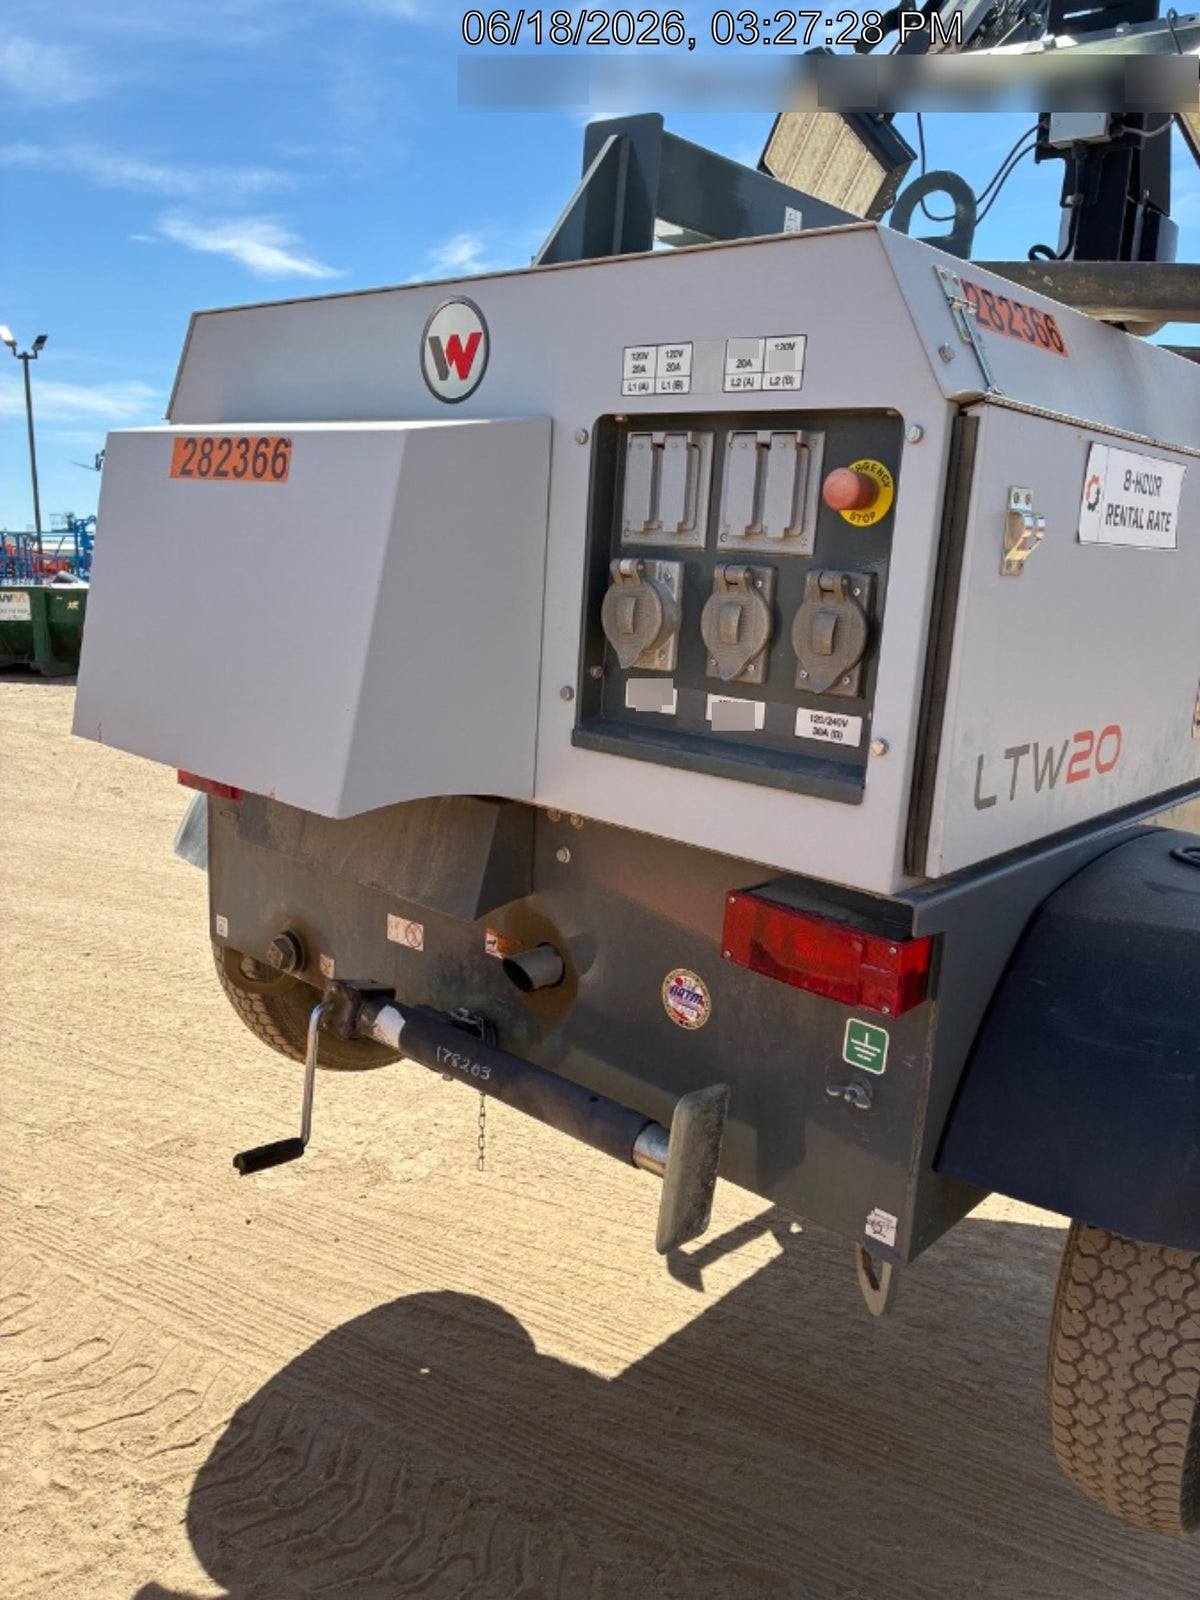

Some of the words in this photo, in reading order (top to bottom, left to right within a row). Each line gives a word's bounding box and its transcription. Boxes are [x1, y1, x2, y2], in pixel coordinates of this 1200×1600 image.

[965, 281, 1064, 353] 282366
[774, 342, 796, 351] 120V
[631, 352, 650, 361] 120V
[665, 350, 684, 359] 120V
[736, 359, 753, 369] 20A
[627, 383, 637, 392] L1
[661, 381, 671, 391] L1
[672, 380, 684, 392] (B)
[731, 378, 742, 388] L2
[743, 376, 755, 388] (A)
[769, 376, 781, 387] L2
[179, 436, 292, 480] 282366
[851, 462, 891, 489] RGENCY
[1123, 468, 1162, 497] 8-HOUR
[850, 511, 876, 524] STOP
[1105, 502, 1144, 529] RENTAL
[1146, 509, 1172, 532] RATE
[973, 724, 1123, 811] LTW20
[436, 1045, 492, 1080] 178203
